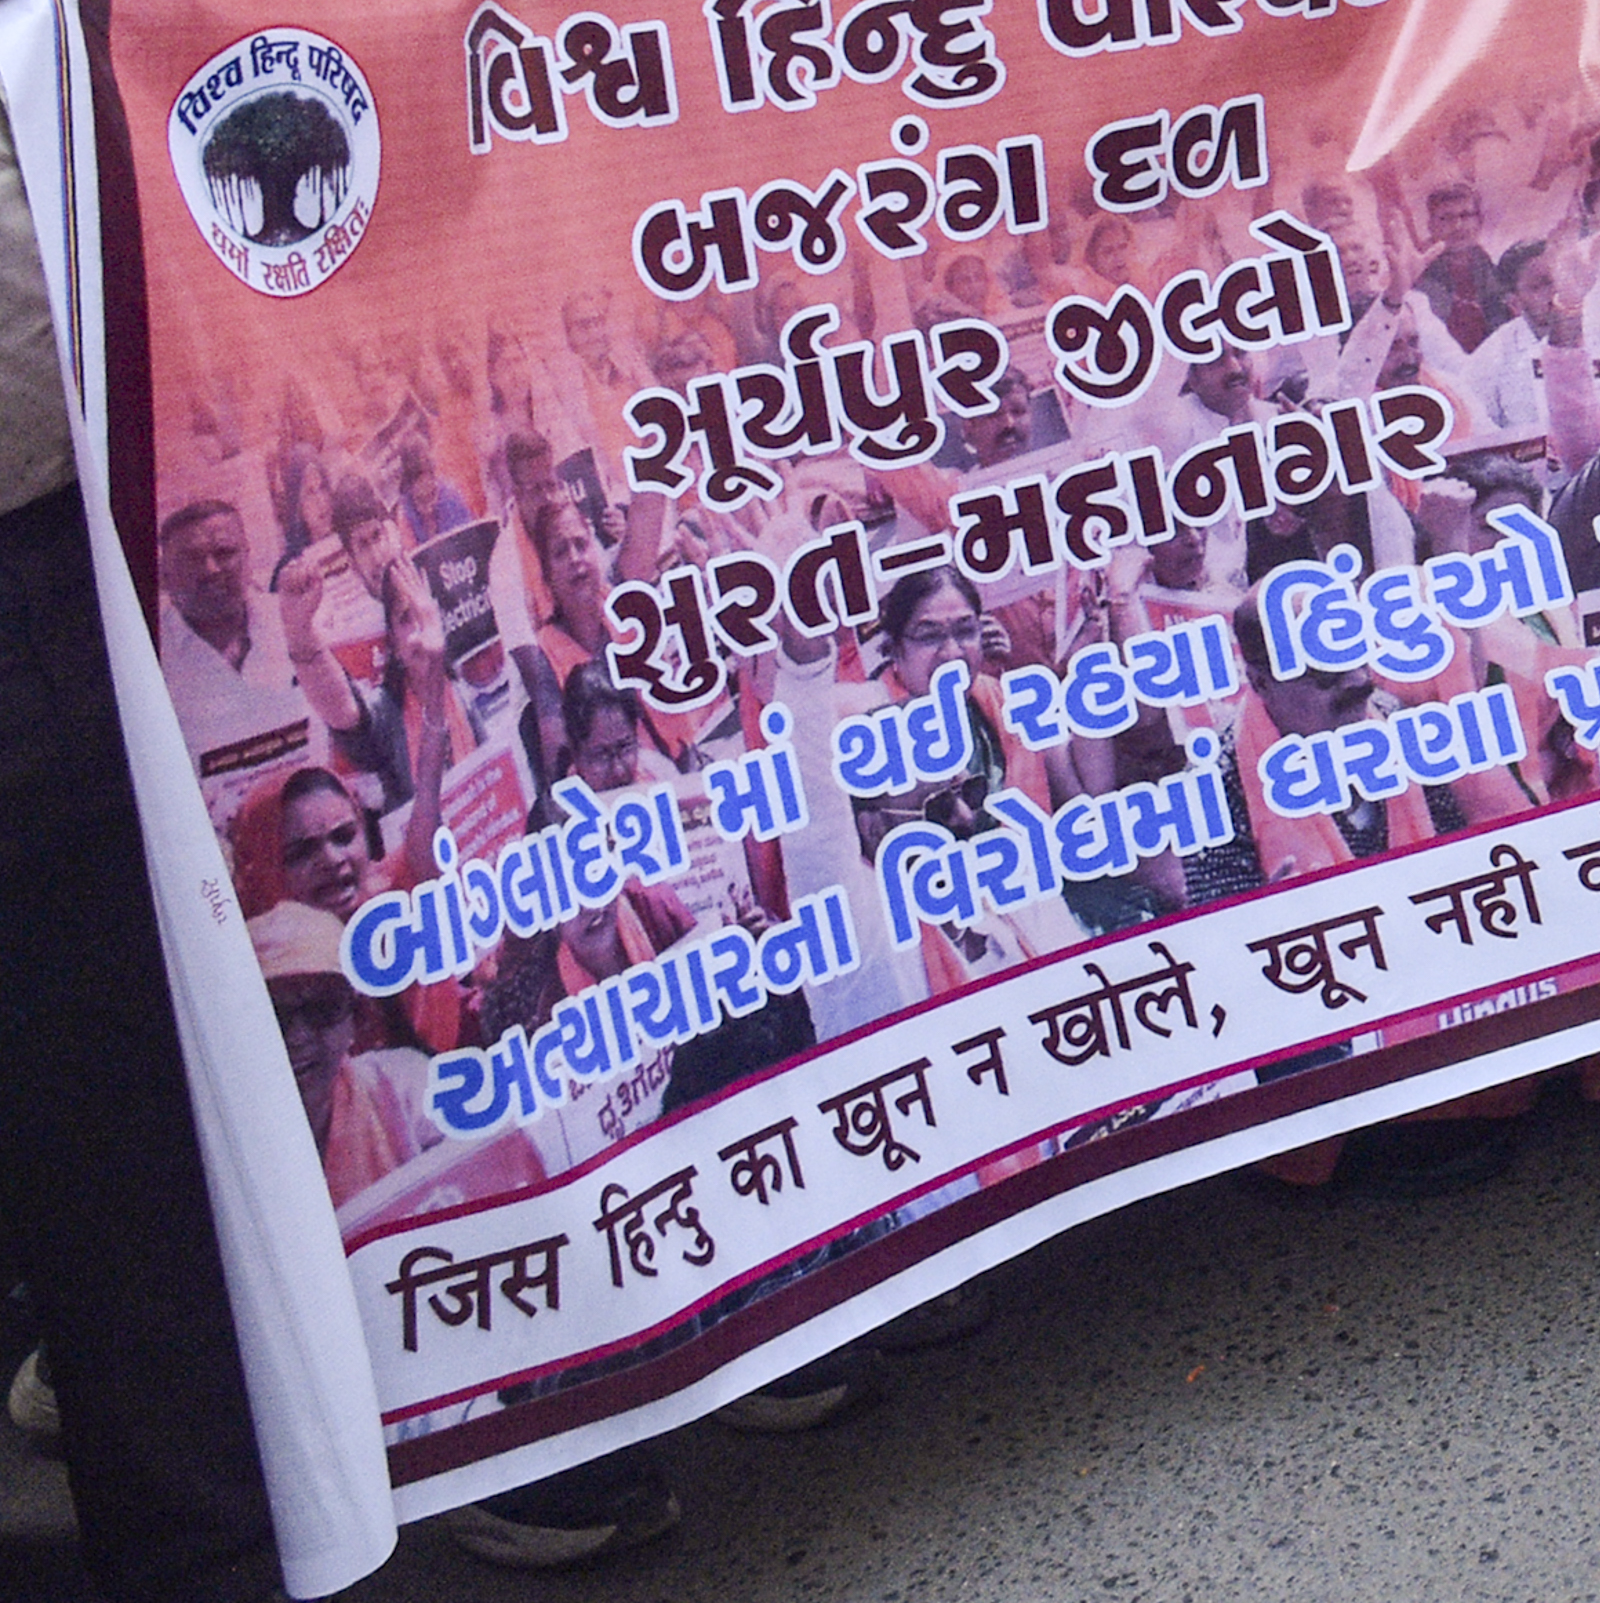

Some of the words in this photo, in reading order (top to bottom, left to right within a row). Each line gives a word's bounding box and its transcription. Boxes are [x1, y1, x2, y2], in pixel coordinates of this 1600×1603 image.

[250, 35, 302, 81] हिन्दू
[308, 44, 370, 126] परिषद
[464, 2, 677, 153] વિશ્વ
[260, 251, 311, 293] रक्षति
[636, 116, 1048, 300] બજરંગ
[1086, 97, 1270, 213] દળ
[710, 709, 810, 843] માં
[834, 667, 972, 798] થઈ
[1258, 503, 1575, 684] હિંદુઓ
[425, 883, 859, 1137] અત્યાચારના
[872, 741, 1235, 950] વિરોધમાં
[1260, 685, 1528, 821] ધરણા
[387, 1234, 569, 1355] जिस
[594, 1163, 717, 1290] हिन्दु
[717, 1117, 807, 1208] का
[819, 1056, 937, 1172] खून
[955, 1026, 1012, 1098] न
[1028, 942, 1228, 1066] खोले,
[1247, 903, 1391, 1011] खून
[1410, 843, 1545, 947] नही
